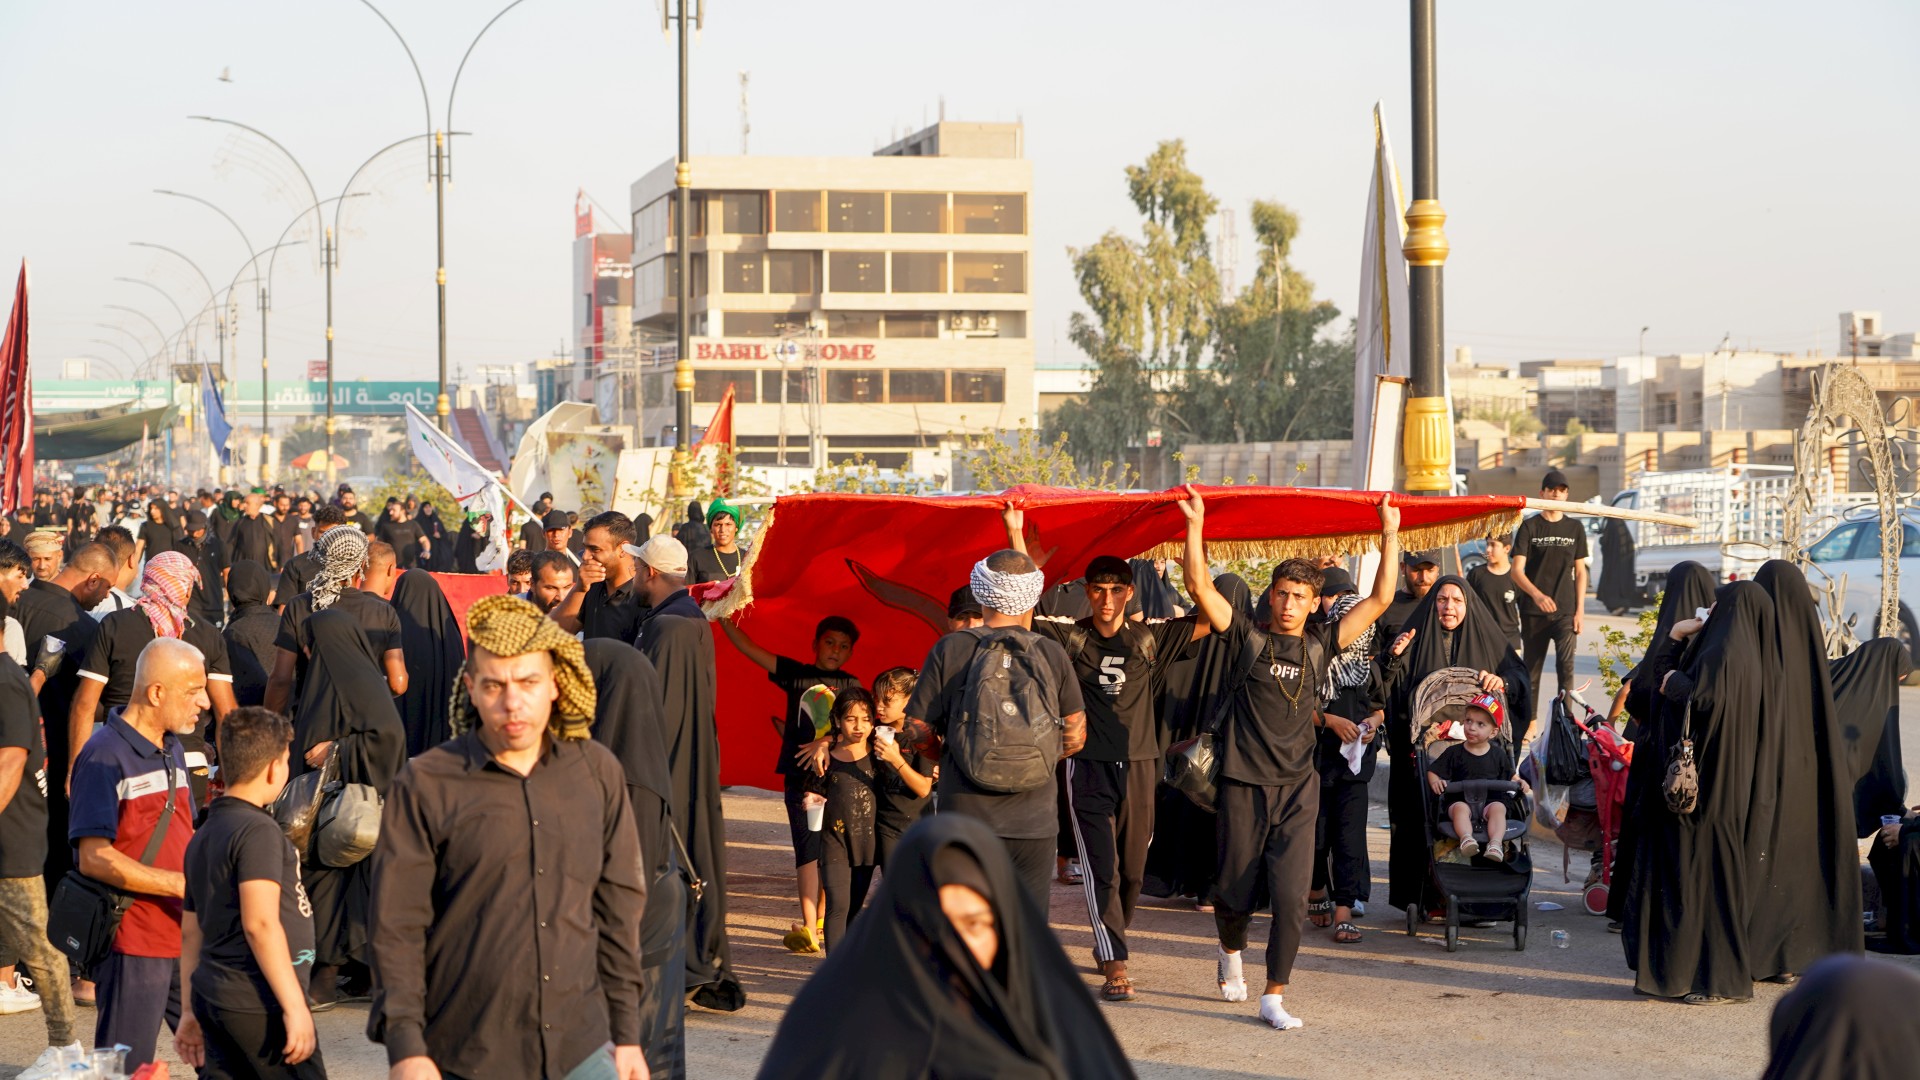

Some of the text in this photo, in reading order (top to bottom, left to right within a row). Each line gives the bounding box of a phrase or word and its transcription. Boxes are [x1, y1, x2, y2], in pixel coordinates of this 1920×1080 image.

[697, 343, 769, 360] BABIL
[1099, 656, 1126, 685] 5
[1270, 664, 1299, 679] OFF
